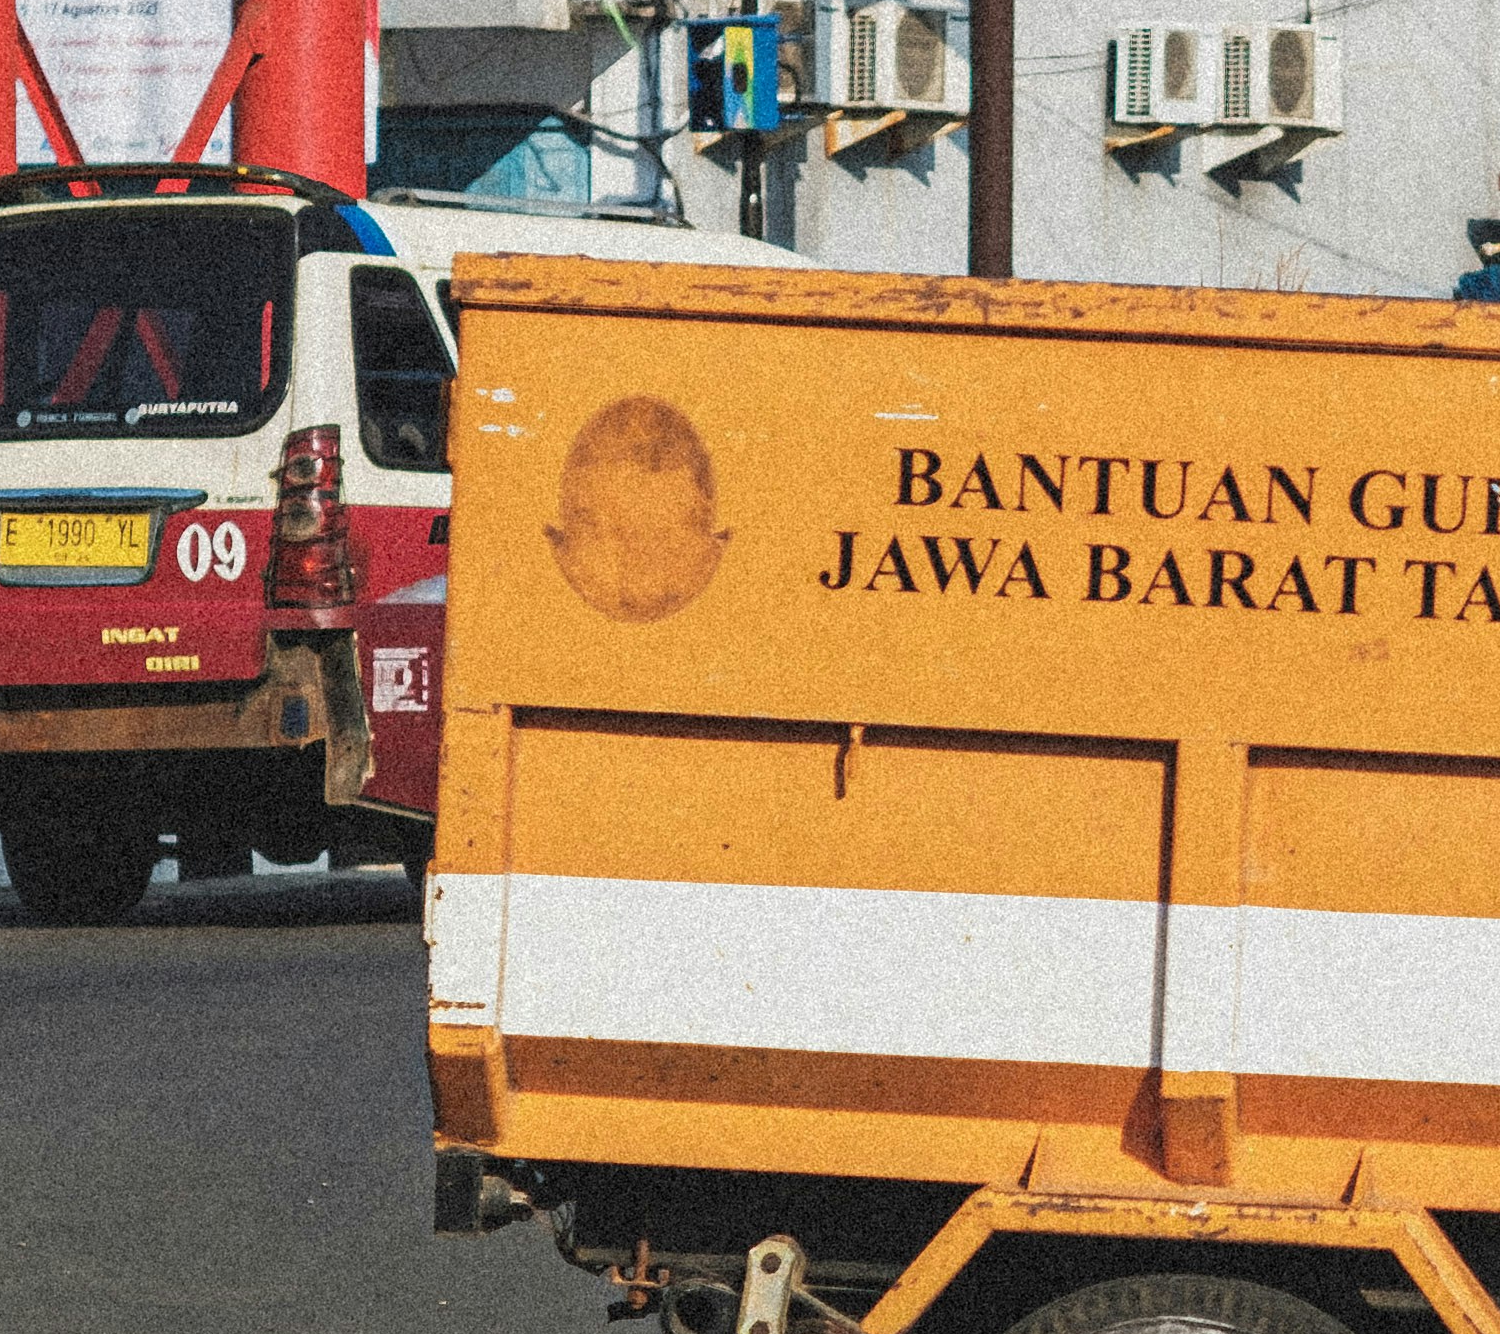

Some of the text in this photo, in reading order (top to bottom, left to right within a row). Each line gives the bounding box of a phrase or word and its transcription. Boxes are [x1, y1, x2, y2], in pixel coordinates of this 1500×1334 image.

[895, 447, 1319, 526] BANTUAN
[5, 518, 140, 548] E 1990 YL
[176, 521, 247, 582] 09
[819, 531, 1051, 599] JAWA
[1081, 543, 1377, 615] BARAT
[101, 625, 180, 645] INGAT
